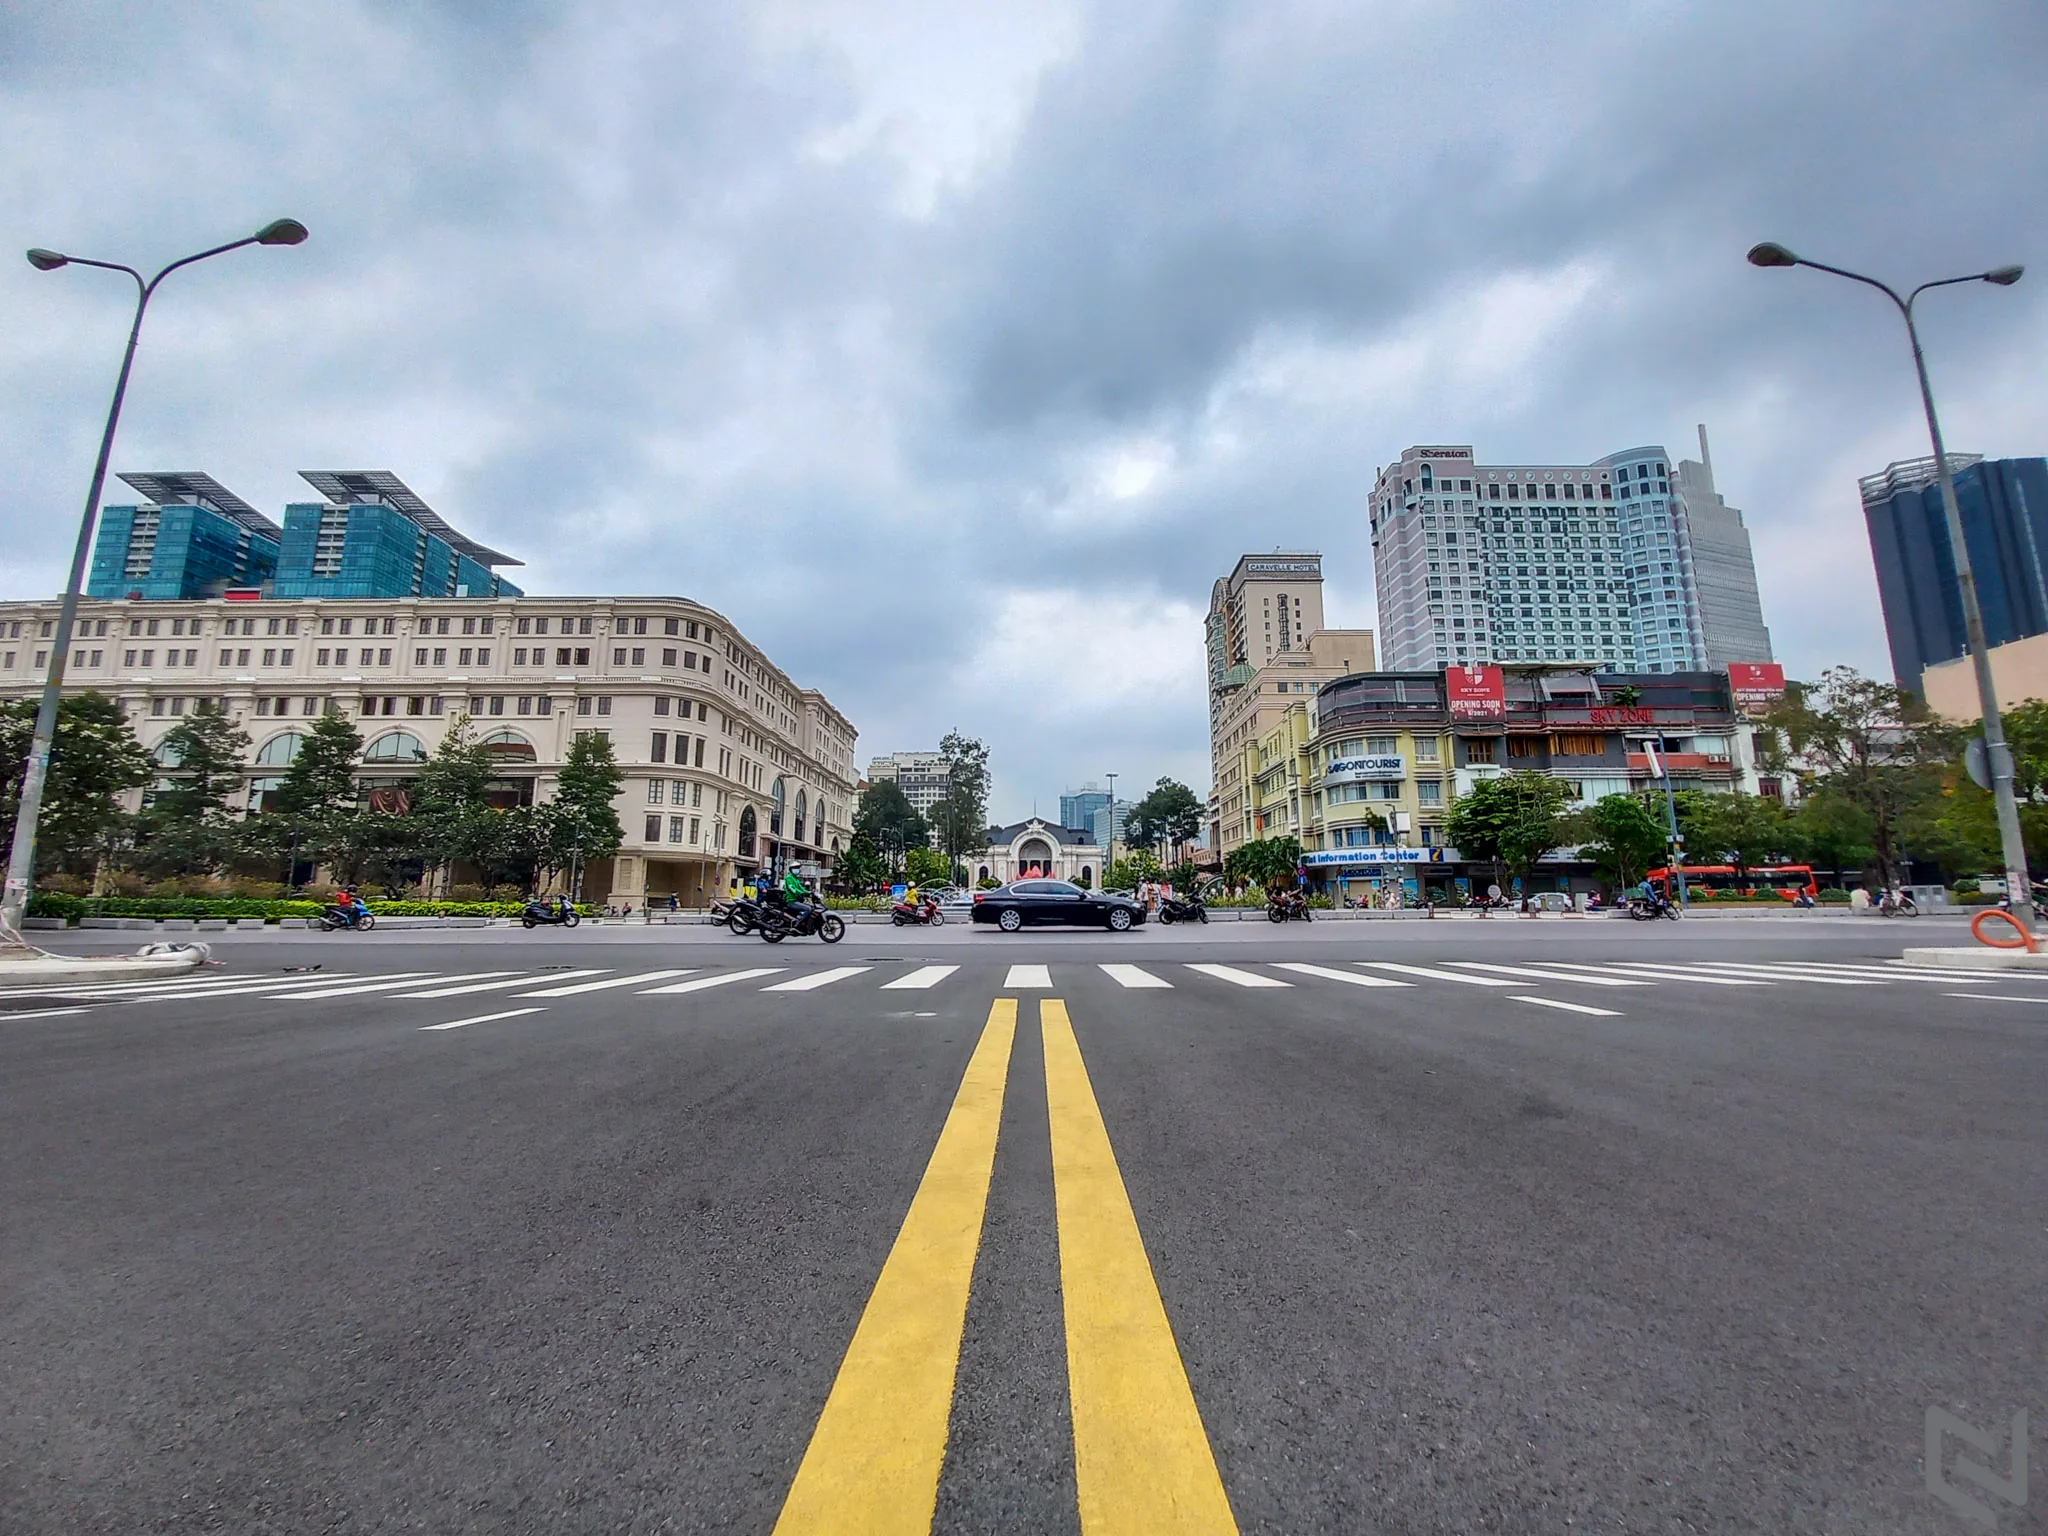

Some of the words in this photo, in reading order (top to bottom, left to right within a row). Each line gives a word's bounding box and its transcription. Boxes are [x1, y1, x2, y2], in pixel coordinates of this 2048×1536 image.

[1736, 693, 1766, 701] OPENING
[1451, 700, 1481, 708] OPENING
[1482, 700, 1500, 708] SOON
[1591, 708, 1615, 722] SKY
[1620, 708, 1653, 722] ZONE
[1328, 759, 1402, 774] SAIGONTOURIST
